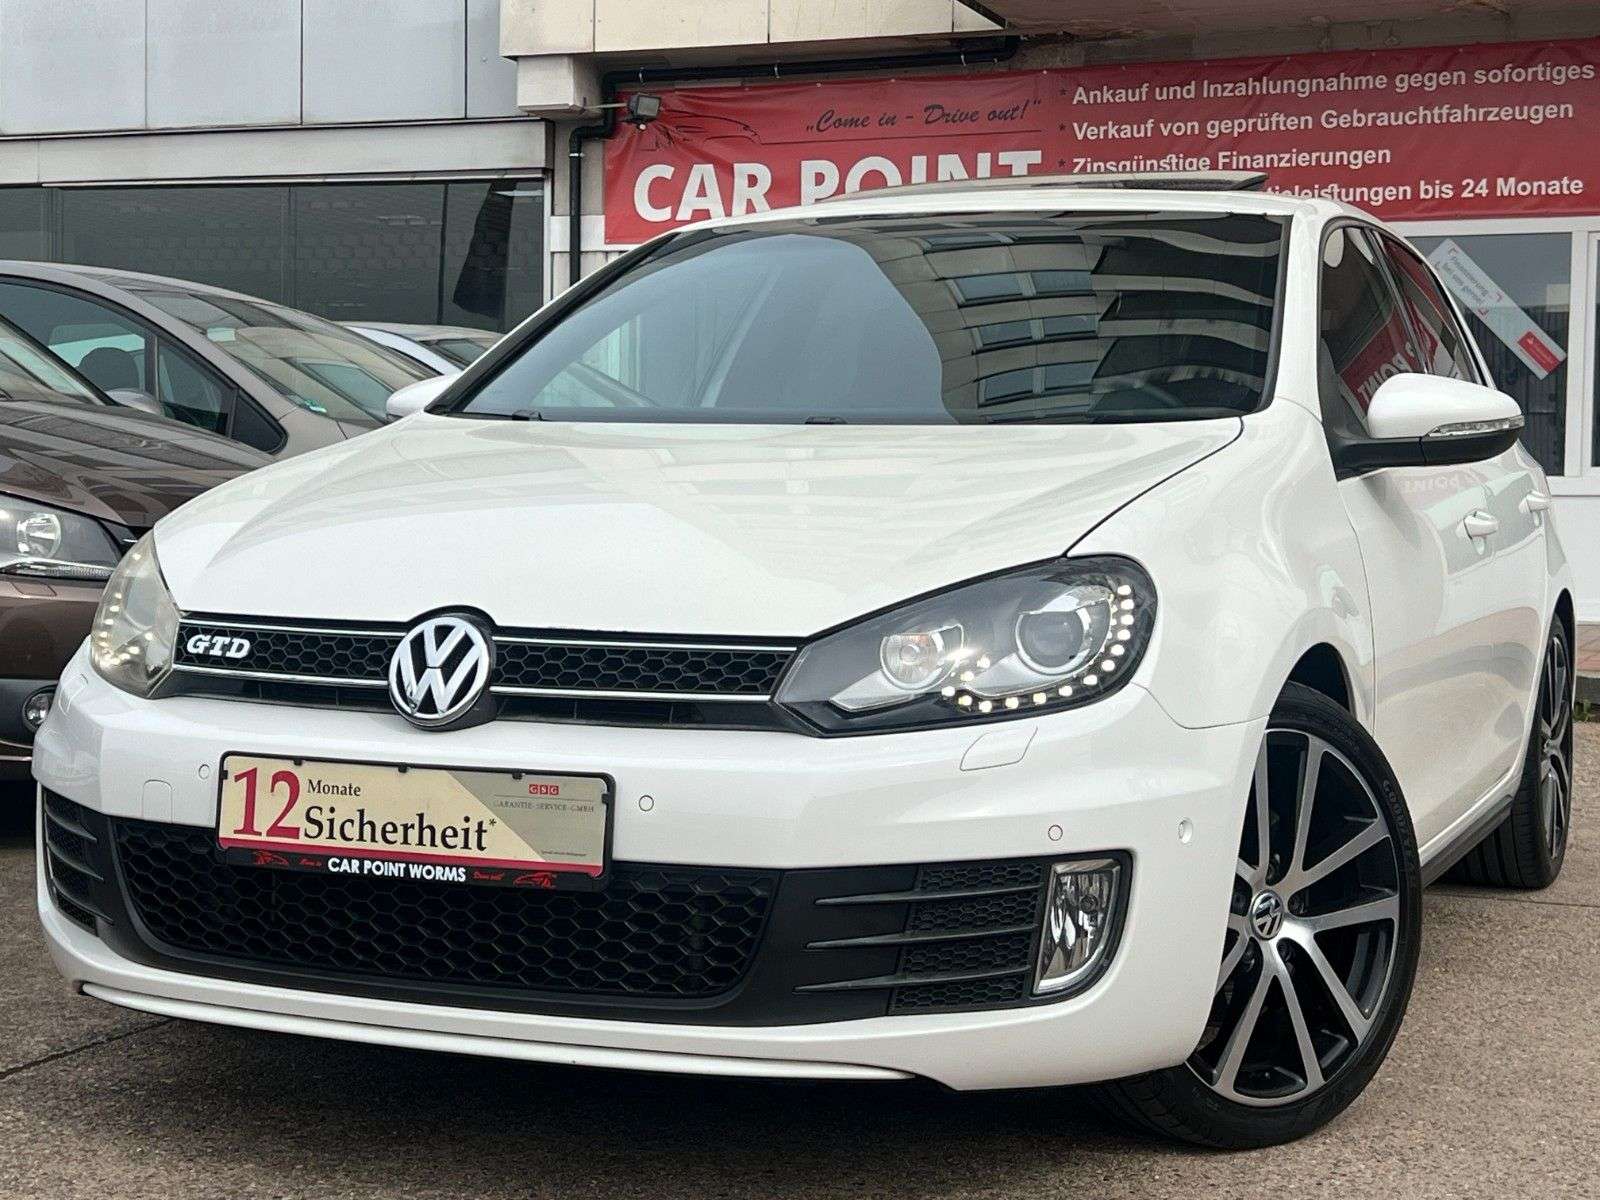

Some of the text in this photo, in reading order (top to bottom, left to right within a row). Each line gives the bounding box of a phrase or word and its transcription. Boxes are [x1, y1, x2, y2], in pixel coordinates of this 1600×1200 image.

[1073, 61, 1595, 104] Ankauf und Inzahlungnahme gegen sofortiges
[878, 112, 898, 127] in
[924, 104, 981, 125] Drive
[1073, 103, 1574, 140] Verkauf von geprüften Gebrauchtfahrzeugen
[1217, 148, 1392, 170] Finanzierungen
[633, 163, 773, 223] CAR
[1420, 178, 1454, 199] bis
[1461, 177, 1489, 198] 24
[1496, 176, 1584, 197] Monate
[186, 634, 251, 661] GTD
[528, 783, 559, 796] GSG
[232, 767, 361, 839] 12 Monate
[327, 857, 360, 874] CAR
[363, 860, 411, 878] POINT
[413, 863, 466, 882] WORMS
